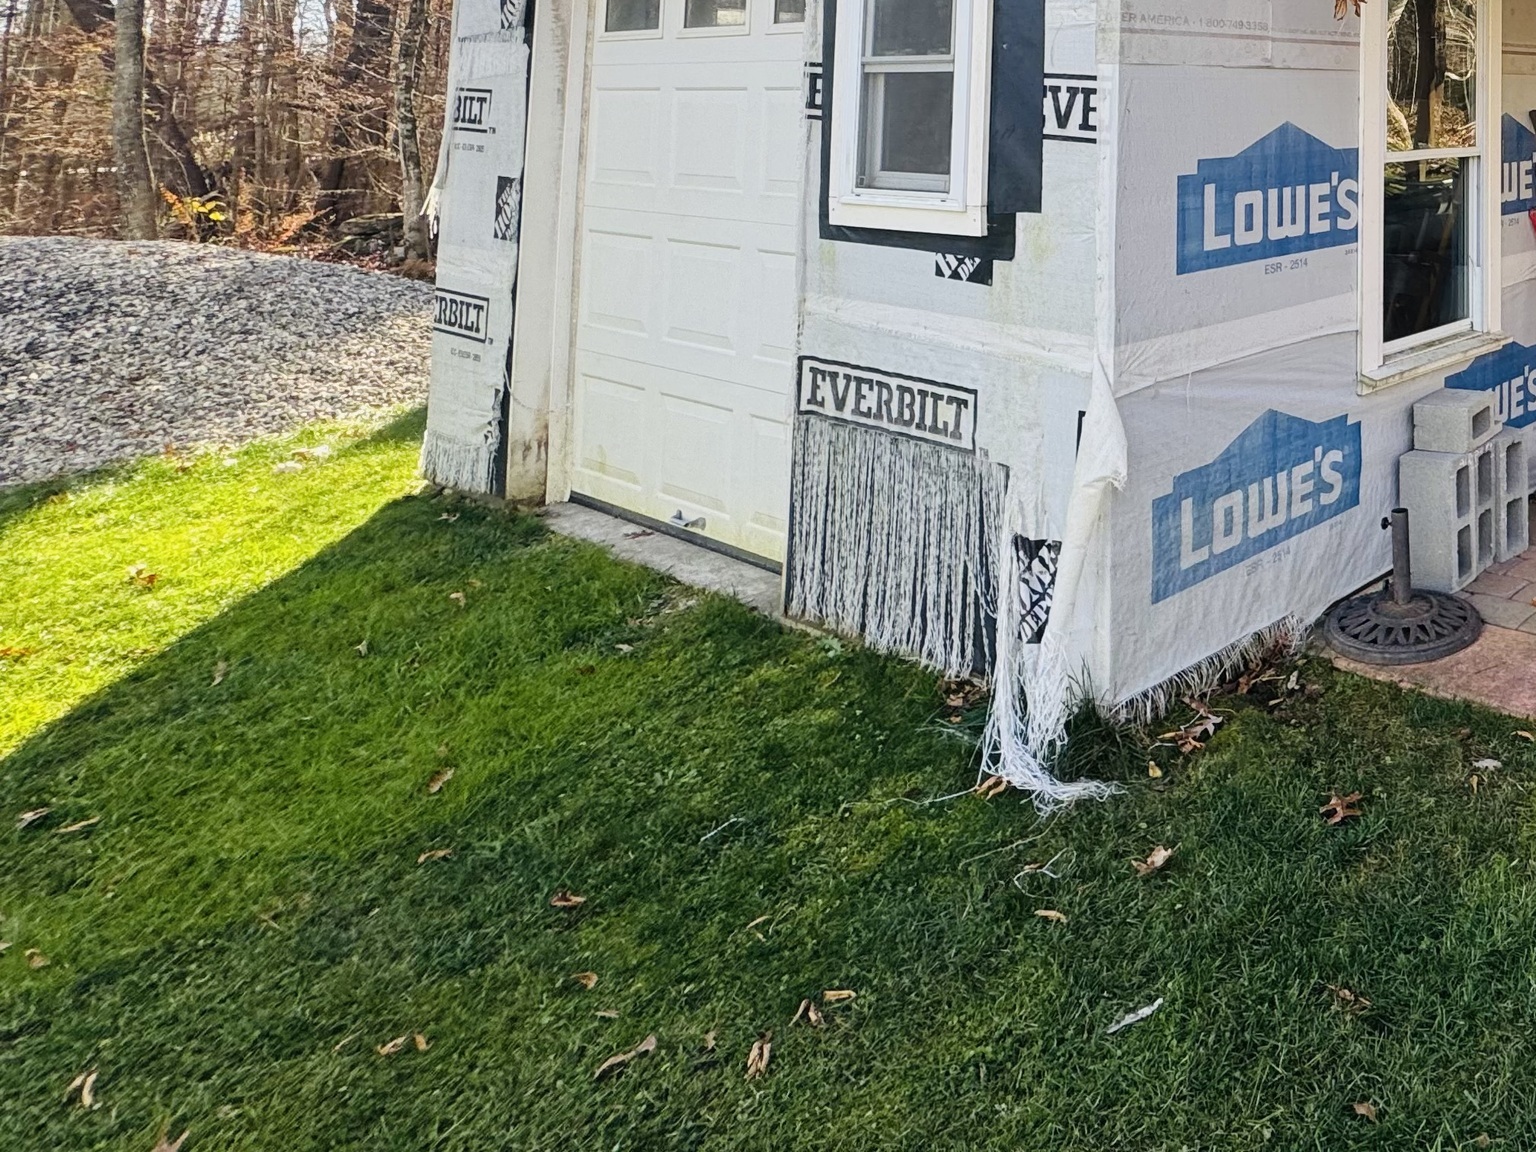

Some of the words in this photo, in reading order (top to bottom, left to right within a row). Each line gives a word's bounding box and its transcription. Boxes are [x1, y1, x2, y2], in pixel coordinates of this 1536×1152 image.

[1203, 171, 1358, 252] LOWE'S
[807, 366, 968, 441] EVERBILT
[1179, 445, 1343, 571] LOWE'S
